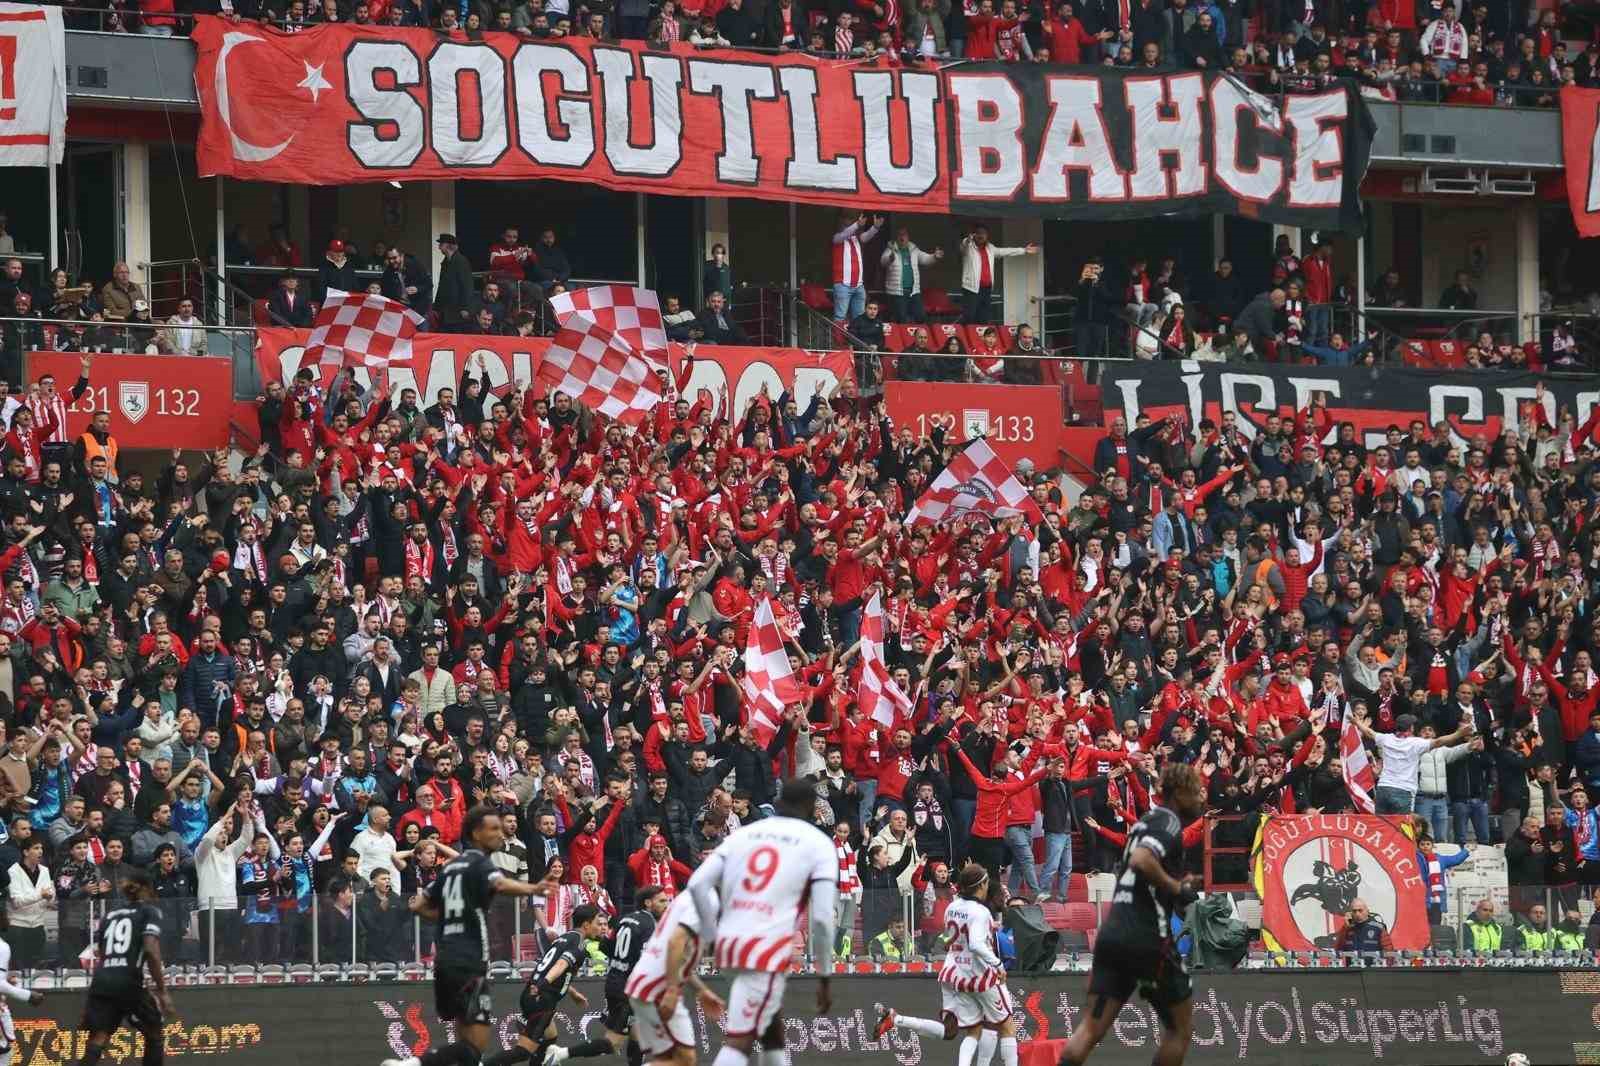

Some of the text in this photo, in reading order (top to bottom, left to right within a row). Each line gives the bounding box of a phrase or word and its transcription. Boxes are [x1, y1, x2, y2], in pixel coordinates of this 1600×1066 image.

[155, 388, 200, 416] 132
[994, 415, 1034, 442] 133
[742, 843, 780, 894] 9
[104, 917, 133, 956] 19
[614, 925, 632, 960] 10
[944, 920, 971, 952] 21
[537, 946, 557, 972] 9
